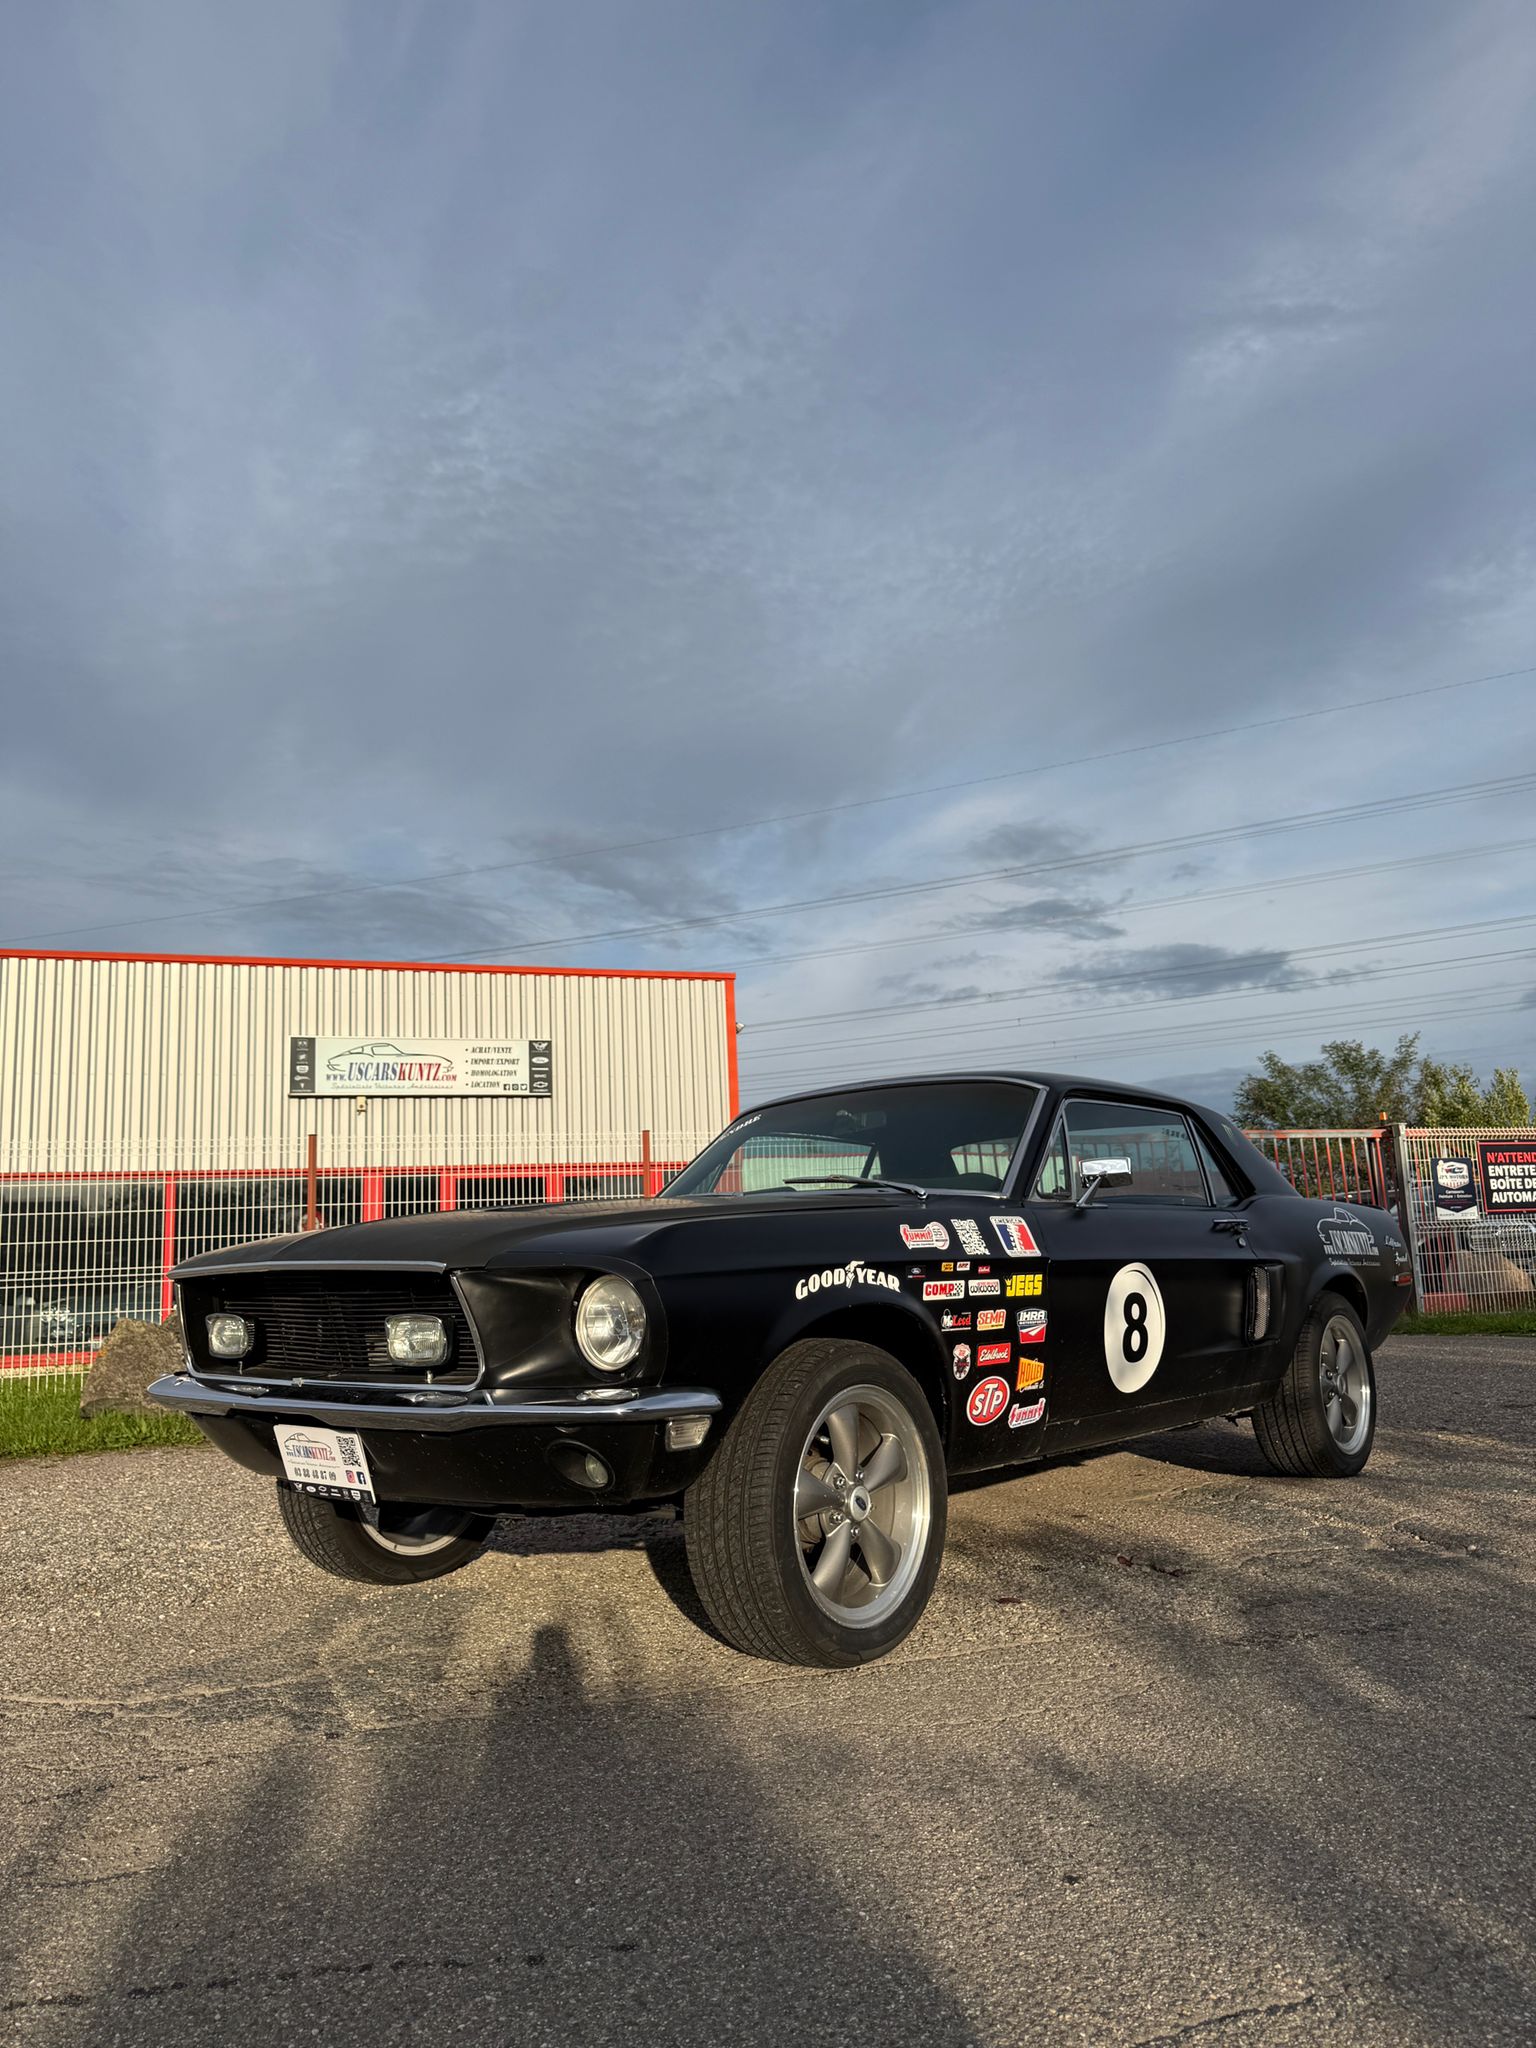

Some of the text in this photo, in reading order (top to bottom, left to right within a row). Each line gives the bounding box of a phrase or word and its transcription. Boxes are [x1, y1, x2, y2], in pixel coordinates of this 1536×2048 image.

[902, 1226, 932, 1242] SUMMIT
[925, 1283, 955, 1296] COMP
[1006, 1274, 1043, 1297] JEGS
[978, 1310, 1006, 1324] SEMA
[1019, 1310, 1045, 1321] IHRA
[1122, 1292, 1148, 1363] 8
[972, 1383, 1003, 1417] STP
